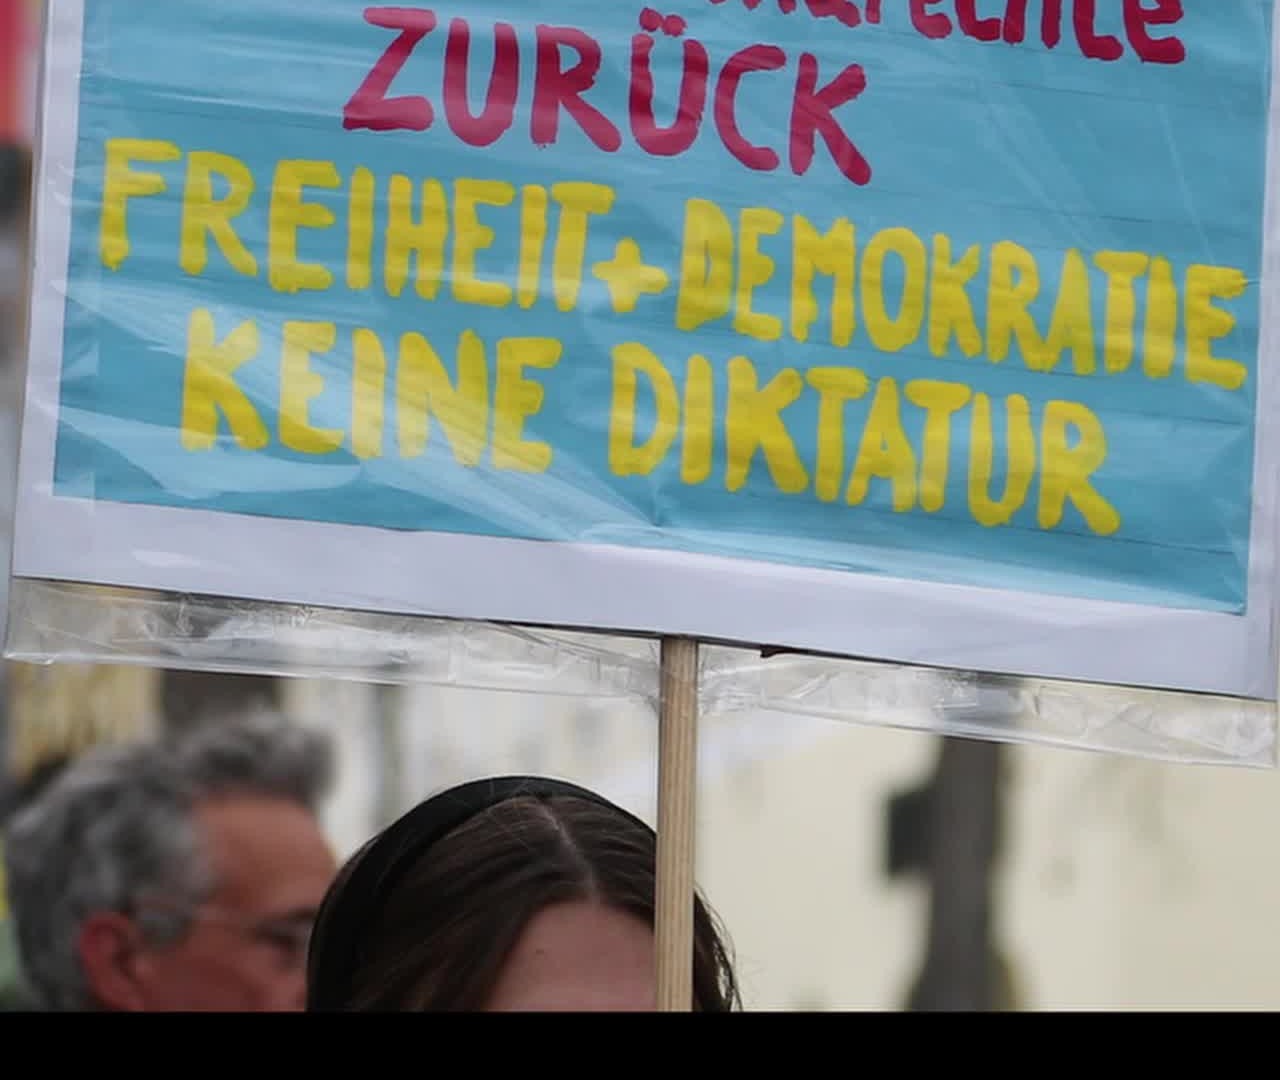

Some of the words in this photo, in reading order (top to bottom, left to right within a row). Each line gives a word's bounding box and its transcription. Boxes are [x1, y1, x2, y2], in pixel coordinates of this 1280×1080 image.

[342, 7, 872, 187] ZURÜCK
[181, 308, 561, 476] KEINE
[608, 342, 1121, 534] DIKTATUR
